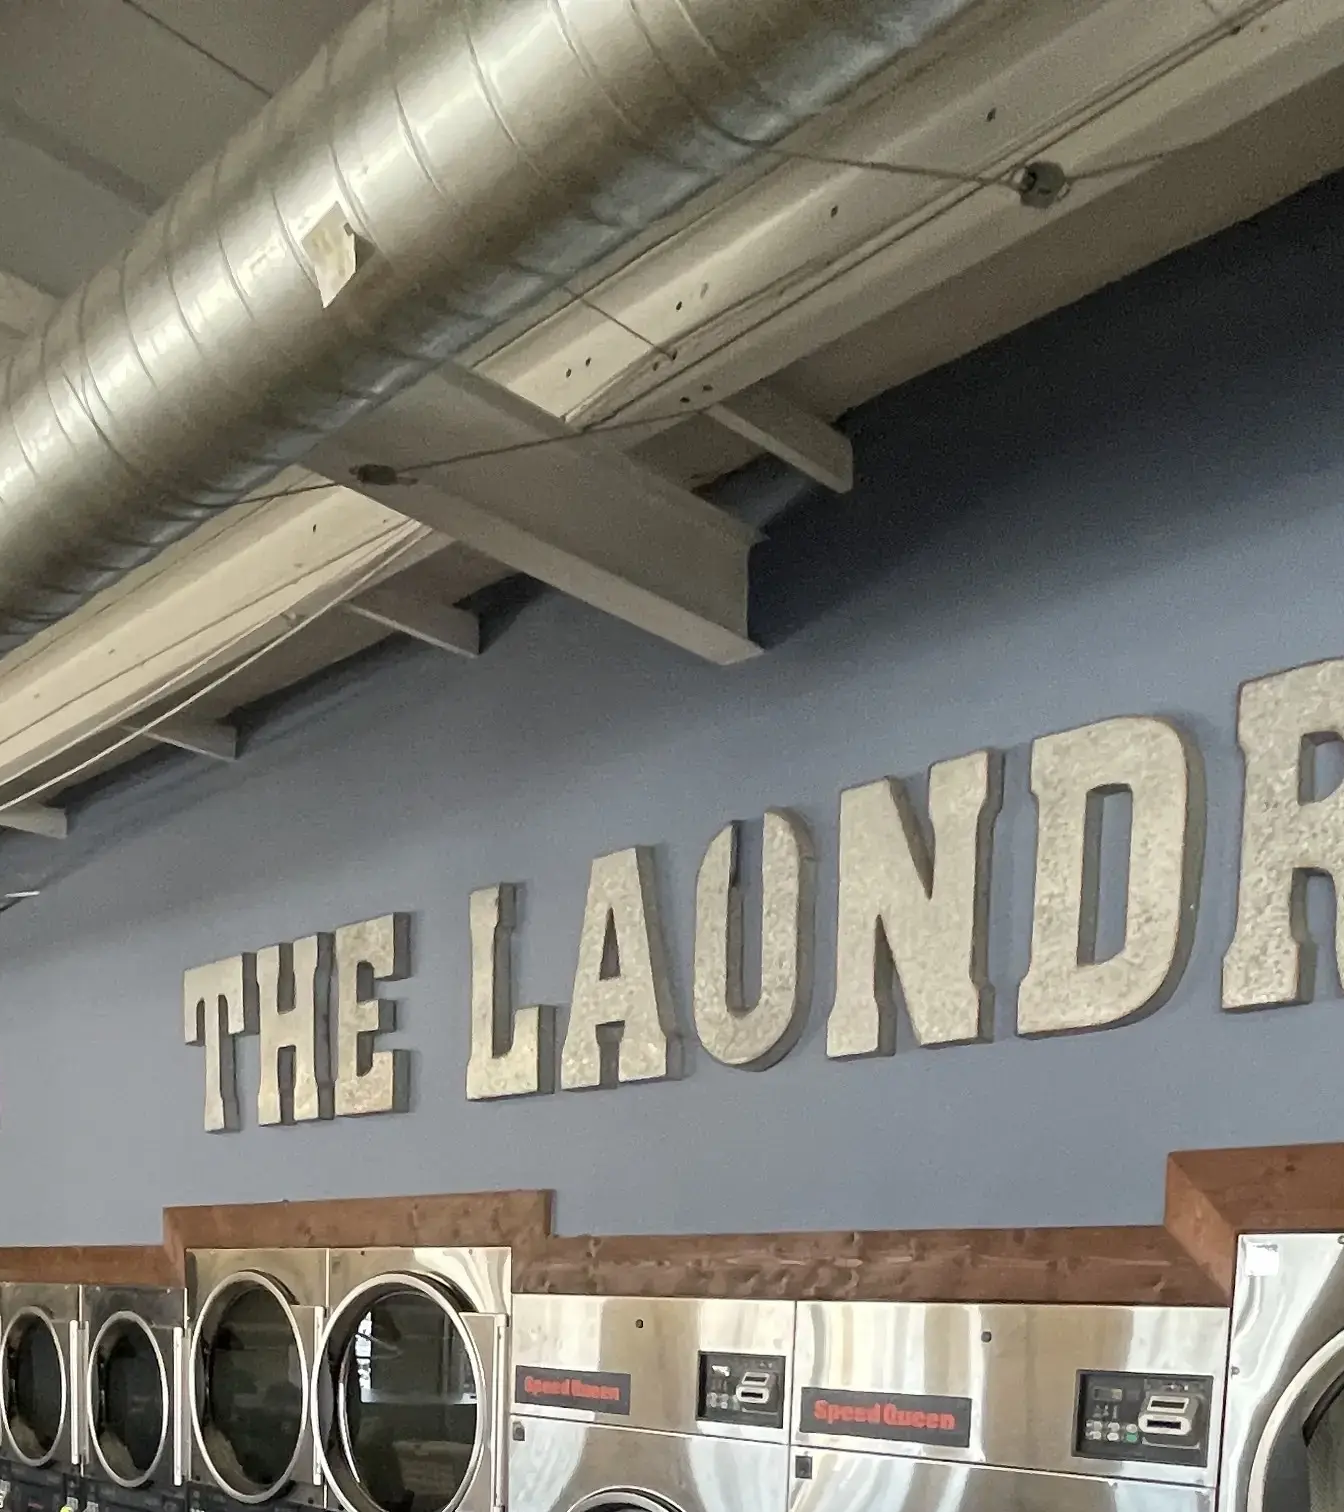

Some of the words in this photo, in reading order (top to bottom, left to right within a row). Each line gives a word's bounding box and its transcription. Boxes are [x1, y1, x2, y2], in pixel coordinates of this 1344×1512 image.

[183, 912, 412, 1132] THE
[524, 1375, 570, 1398] Speed
[571, 1379, 620, 1401] Queen
[813, 1399, 881, 1425] Speed
[882, 1403, 955, 1430] Queen
